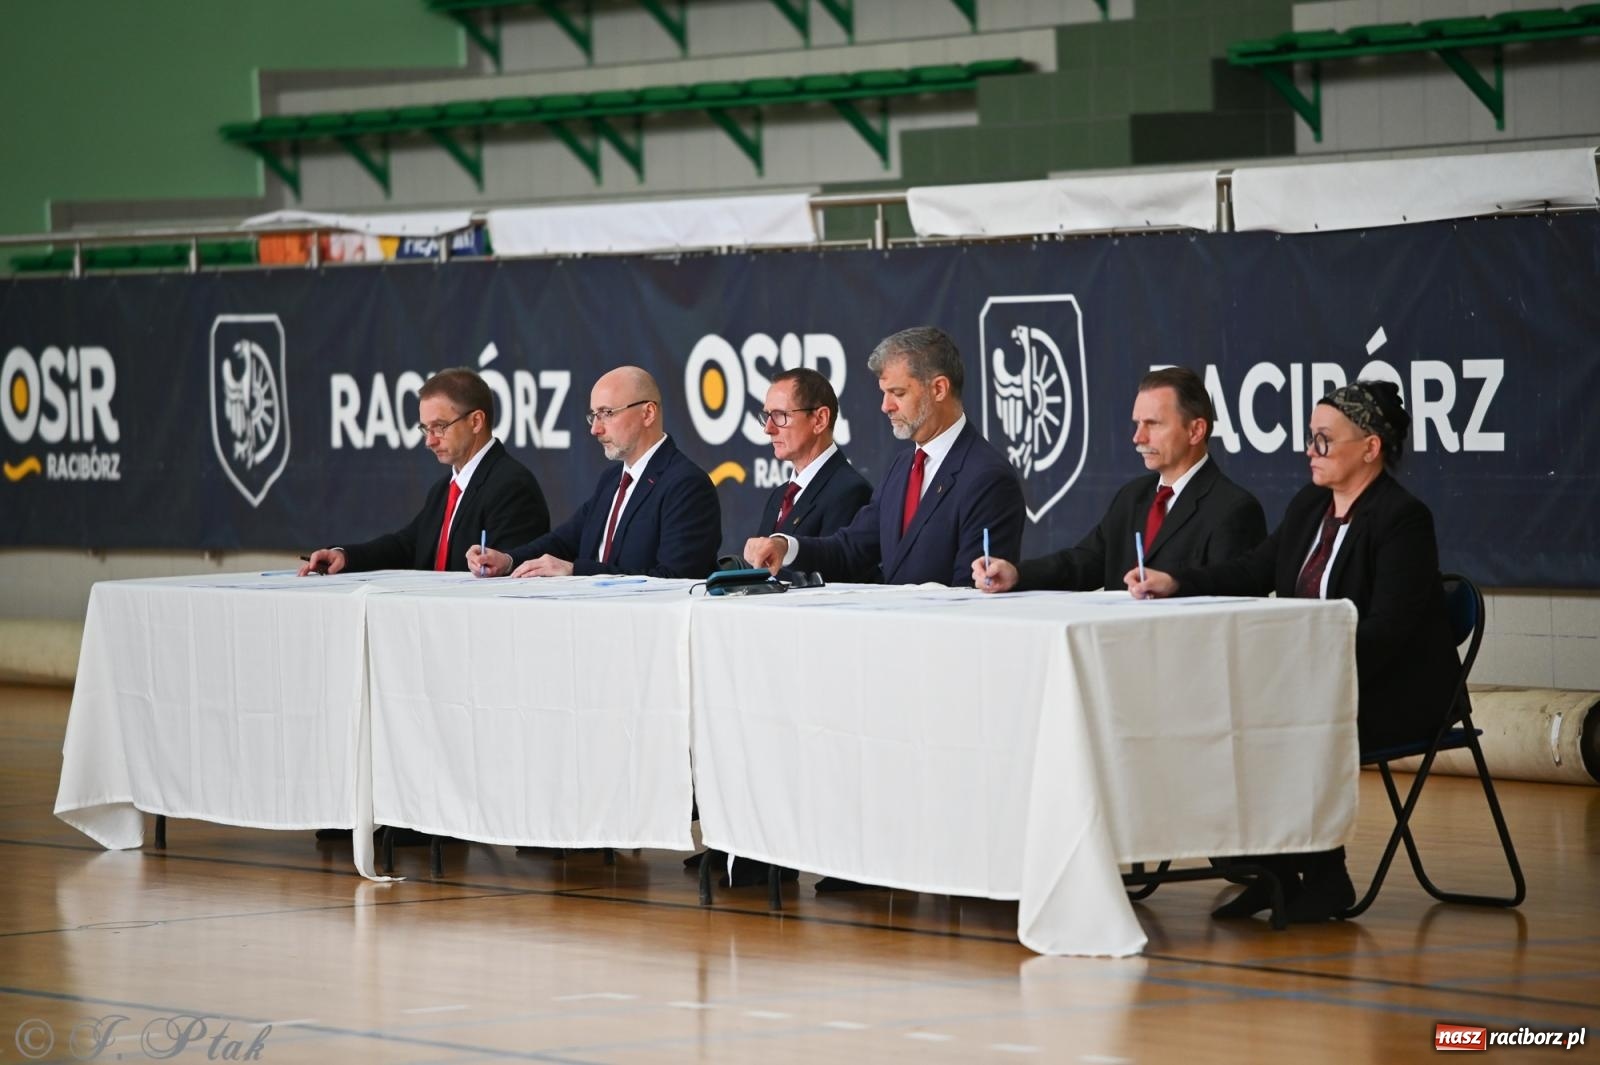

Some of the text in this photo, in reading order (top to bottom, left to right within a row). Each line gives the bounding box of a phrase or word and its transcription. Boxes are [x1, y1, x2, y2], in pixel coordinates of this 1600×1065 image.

[0, 345, 120, 443] OSiR
[330, 341, 571, 449] RACÓRZ
[46, 445, 121, 480] RACIBÓRZ
